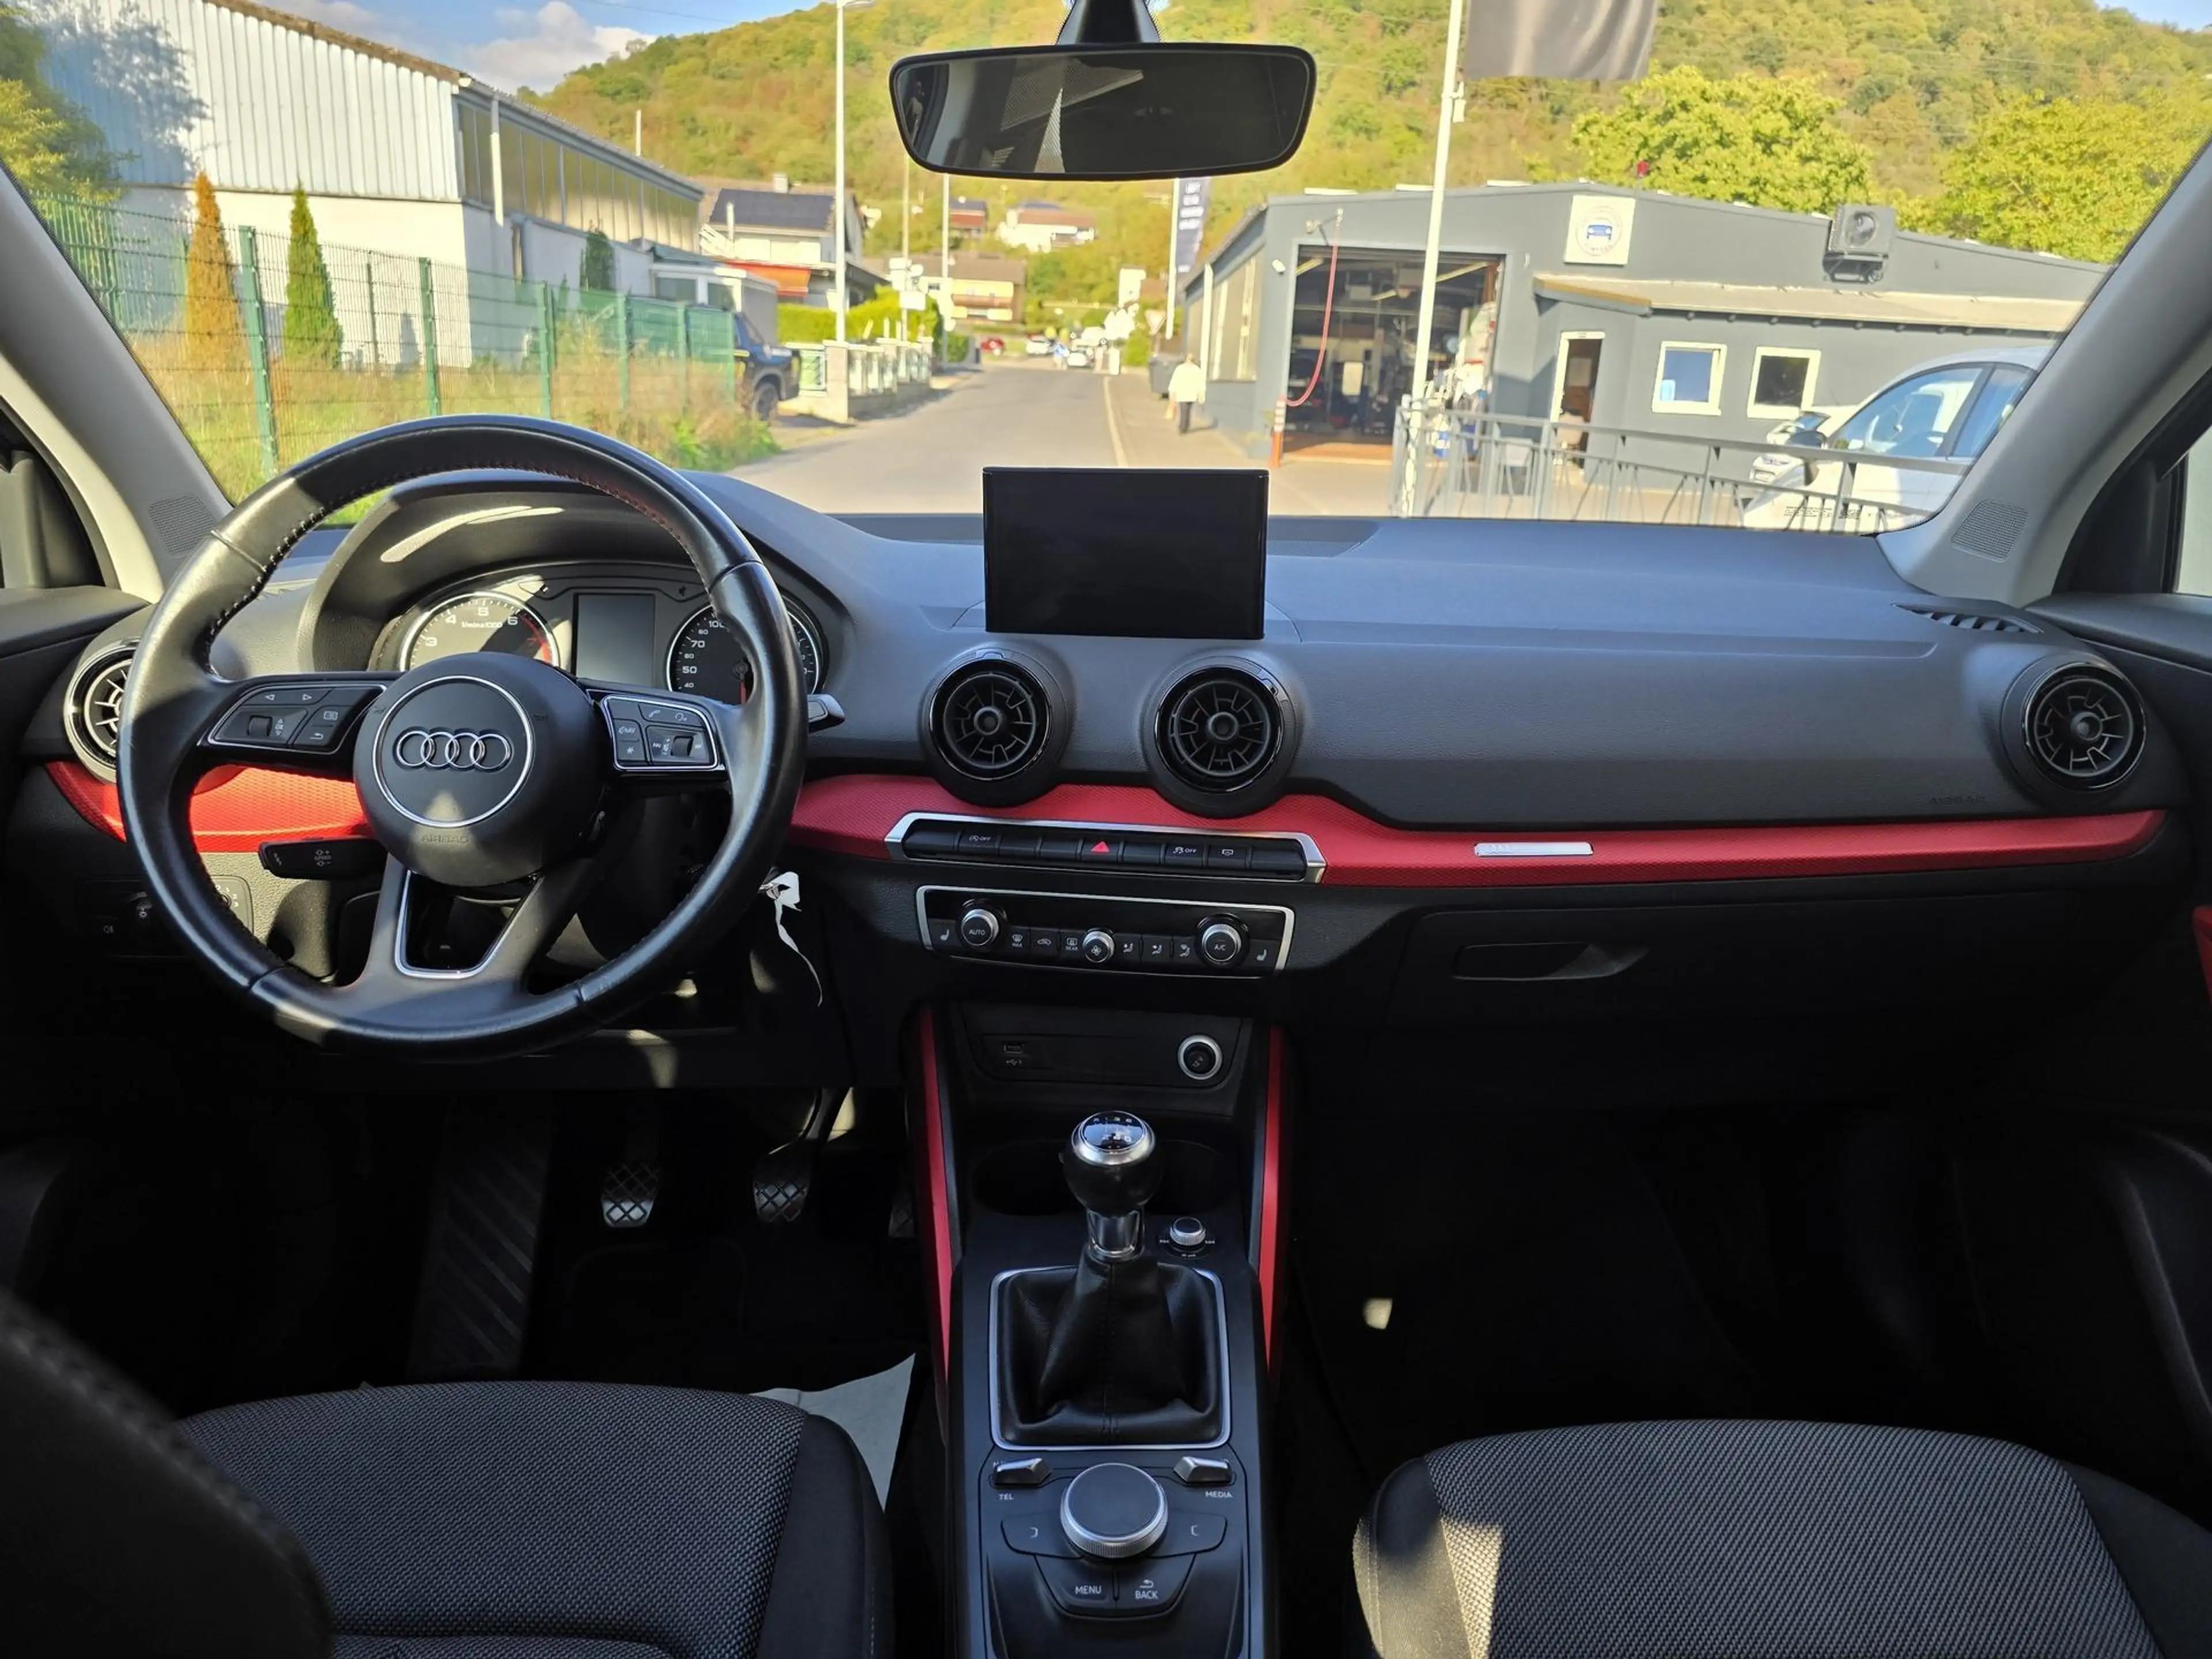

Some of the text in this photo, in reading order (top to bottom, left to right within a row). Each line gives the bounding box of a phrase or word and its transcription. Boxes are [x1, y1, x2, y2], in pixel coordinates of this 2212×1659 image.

[478, 607, 488, 616] 5
[445, 615, 456, 624] 4
[507, 616, 518, 625] 6
[425, 636, 437, 647] 3
[691, 640, 706, 648] 70
[682, 666, 698, 674] 50
[1205, 1490, 1233, 1498] MEDIA
[1075, 1585, 1102, 1594] MENU
[1135, 1590, 1158, 1600] BACK
